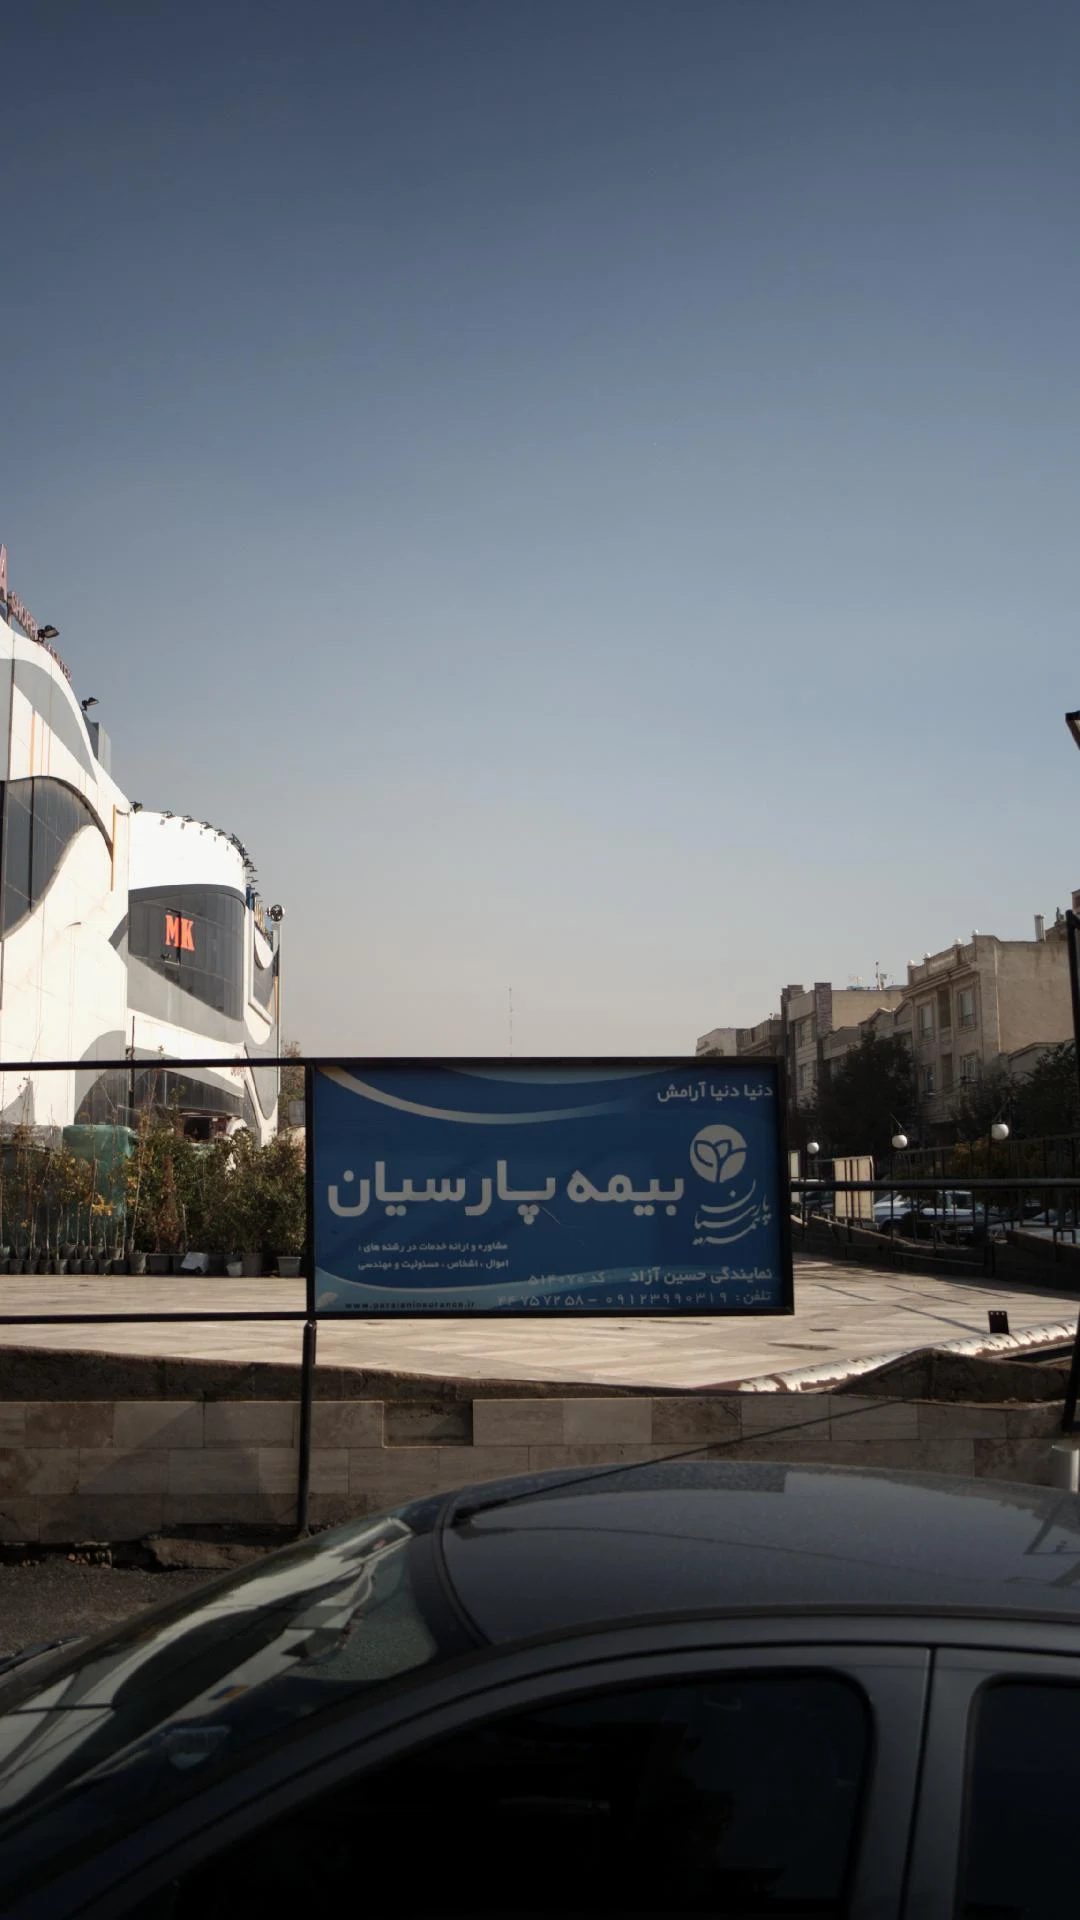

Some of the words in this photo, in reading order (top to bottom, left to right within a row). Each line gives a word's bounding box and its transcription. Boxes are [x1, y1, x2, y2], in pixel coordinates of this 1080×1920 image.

[165, 914, 195, 951] MK
[657, 1081, 707, 1102] آرامش
[709, 1083, 740, 1101] دنیا
[743, 1083, 774, 1100] دنیا
[327, 1159, 556, 1225] پارسیان
[566, 1169, 685, 1216] بیمه
[382, 1242, 405, 1253] رشته
[406, 1244, 417, 1253] در
[419, 1242, 447, 1251] خدمات
[478, 1241, 508, 1253] مشاوره
[358, 1260, 392, 1271] مهندسی
[401, 1260, 439, 1270] مسئولیت
[589, 1271, 606, 1284] کد
[629, 1266, 661, 1285] آزاد
[663, 1271, 706, 1285] حسین
[710, 1266, 773, 1283] نمایندگی
